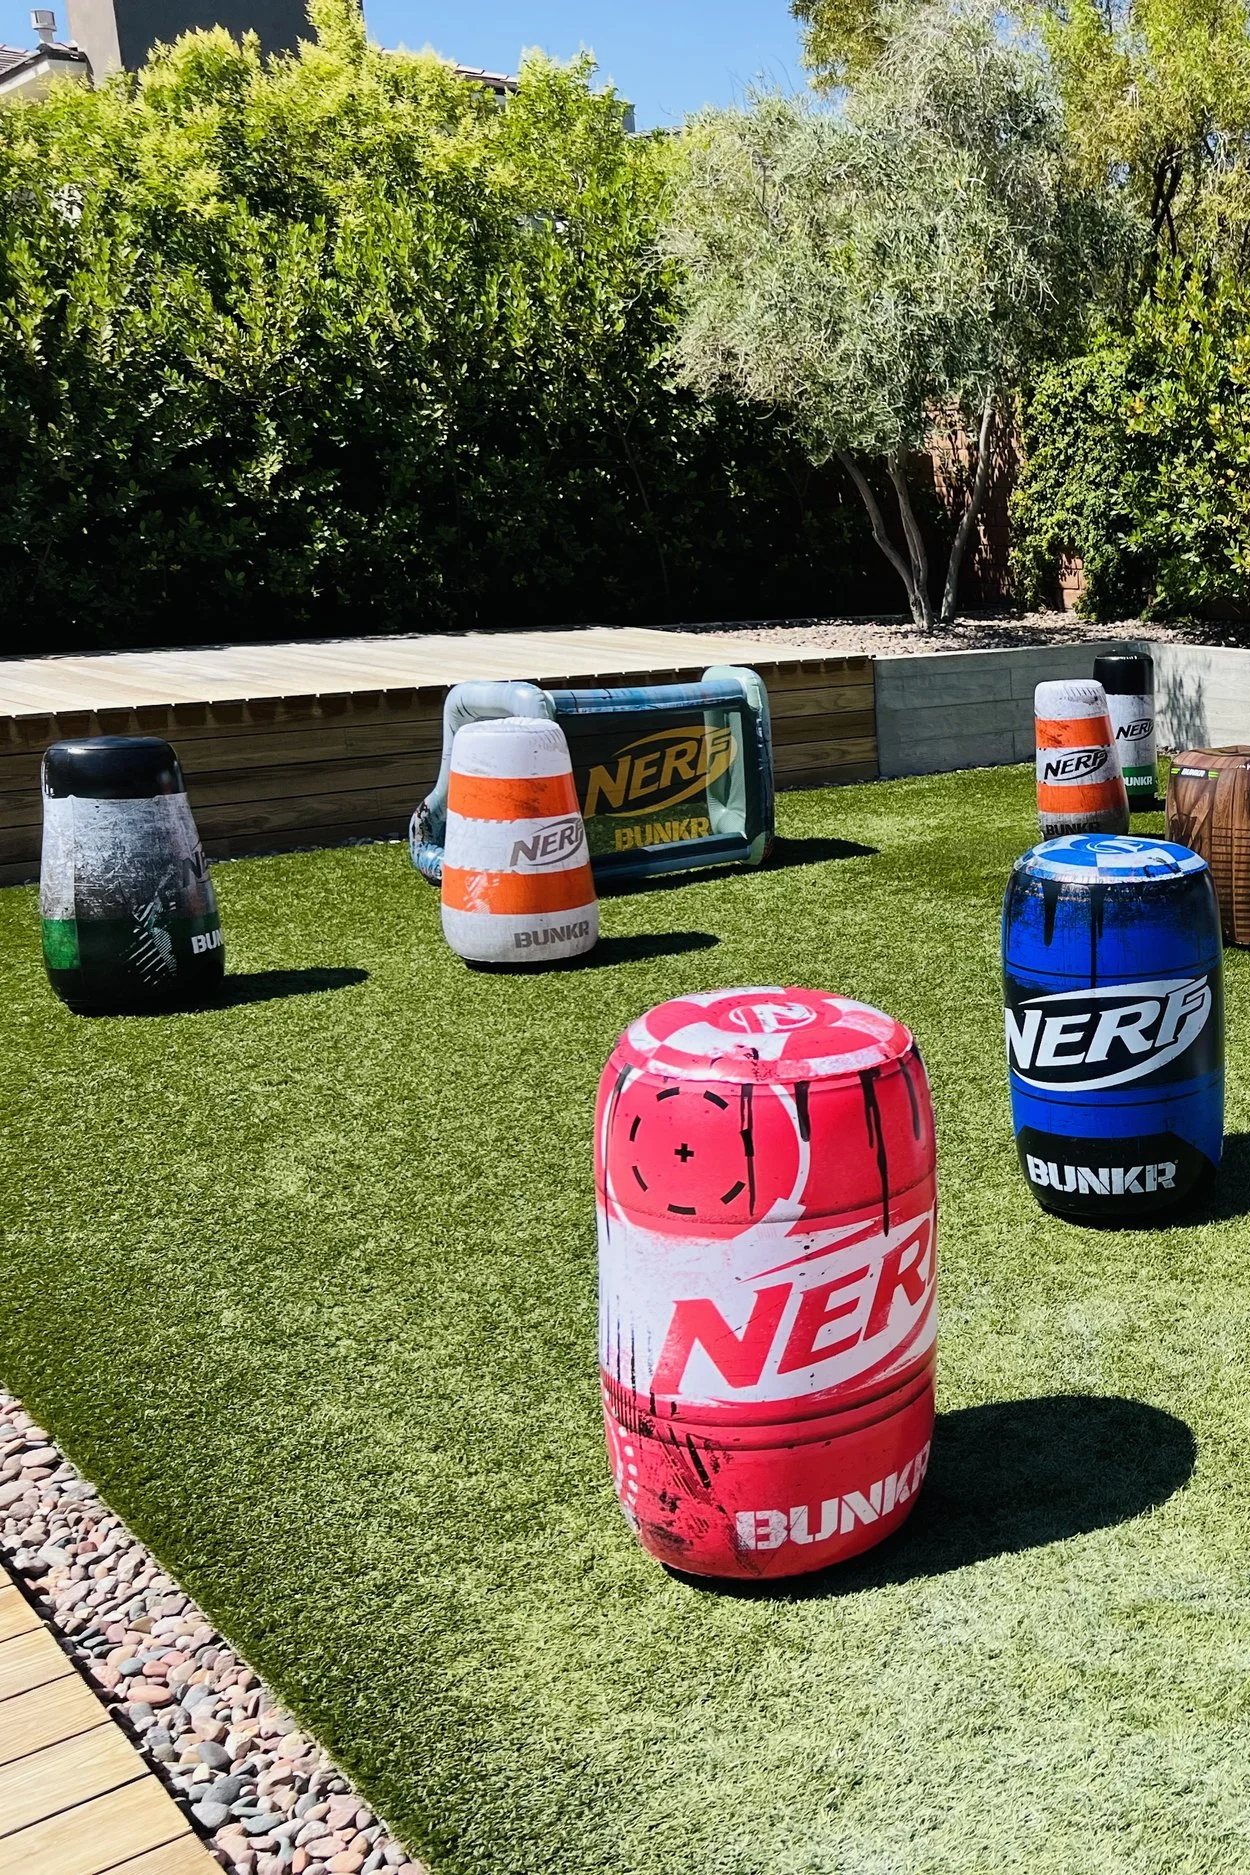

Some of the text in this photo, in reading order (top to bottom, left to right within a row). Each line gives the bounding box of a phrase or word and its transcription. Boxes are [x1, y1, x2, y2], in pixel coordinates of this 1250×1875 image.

[1116, 719, 1154, 740] NERF
[583, 727, 732, 819] NERF
[1044, 750, 1108, 780] NERF
[509, 817, 583, 868] NERF
[614, 816, 710, 851] BUNKR
[514, 920, 590, 949] BUNKR
[1004, 975, 1208, 1070] NERF
[1026, 1153, 1176, 1195] BUNKR
[649, 1212, 937, 1398] NER
[735, 1440, 932, 1551] BUNKR
